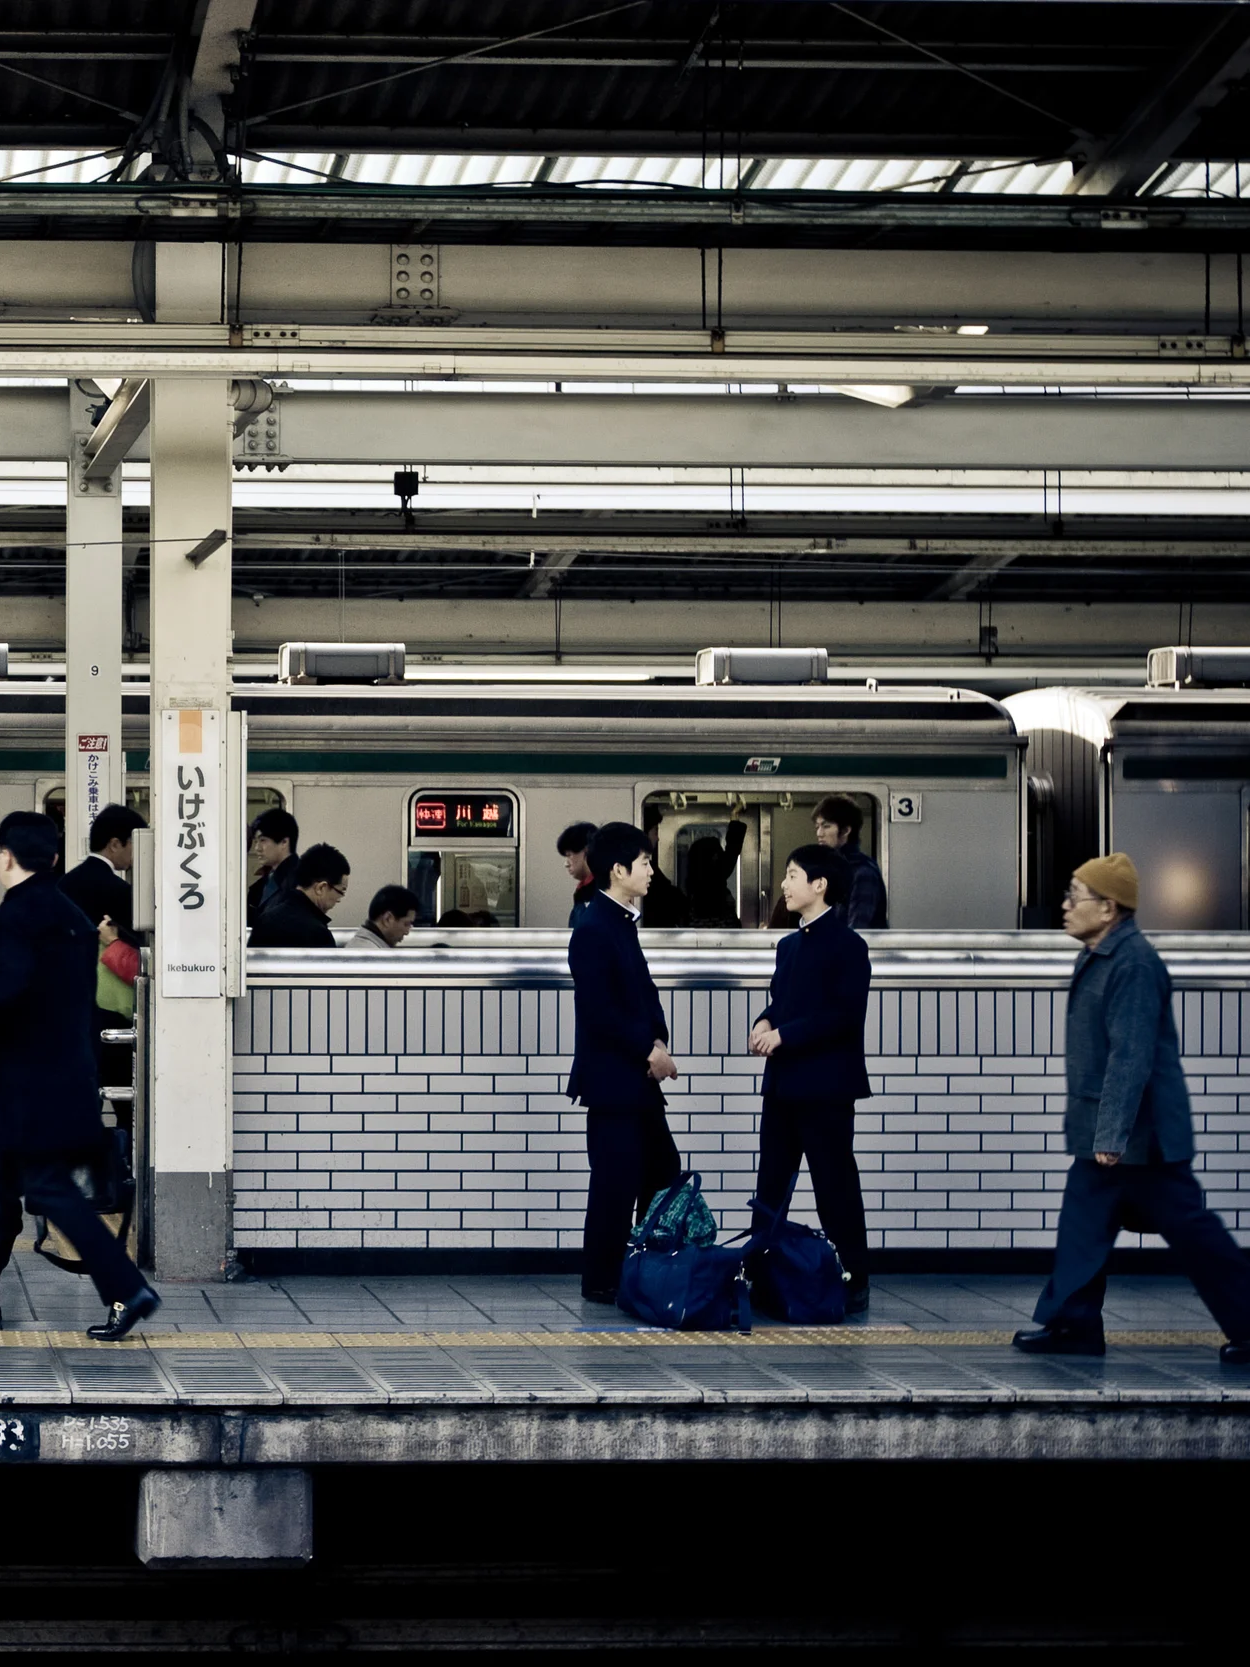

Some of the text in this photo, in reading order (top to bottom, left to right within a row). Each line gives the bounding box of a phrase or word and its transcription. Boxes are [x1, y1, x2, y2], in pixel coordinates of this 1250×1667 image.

[91, 665, 99, 676] 9
[898, 797, 914, 817] 3
[177, 765, 205, 910] いけぶくろ
[167, 962, 216, 973] Ikebukuro
[61, 1433, 131, 1451] H=1.055
